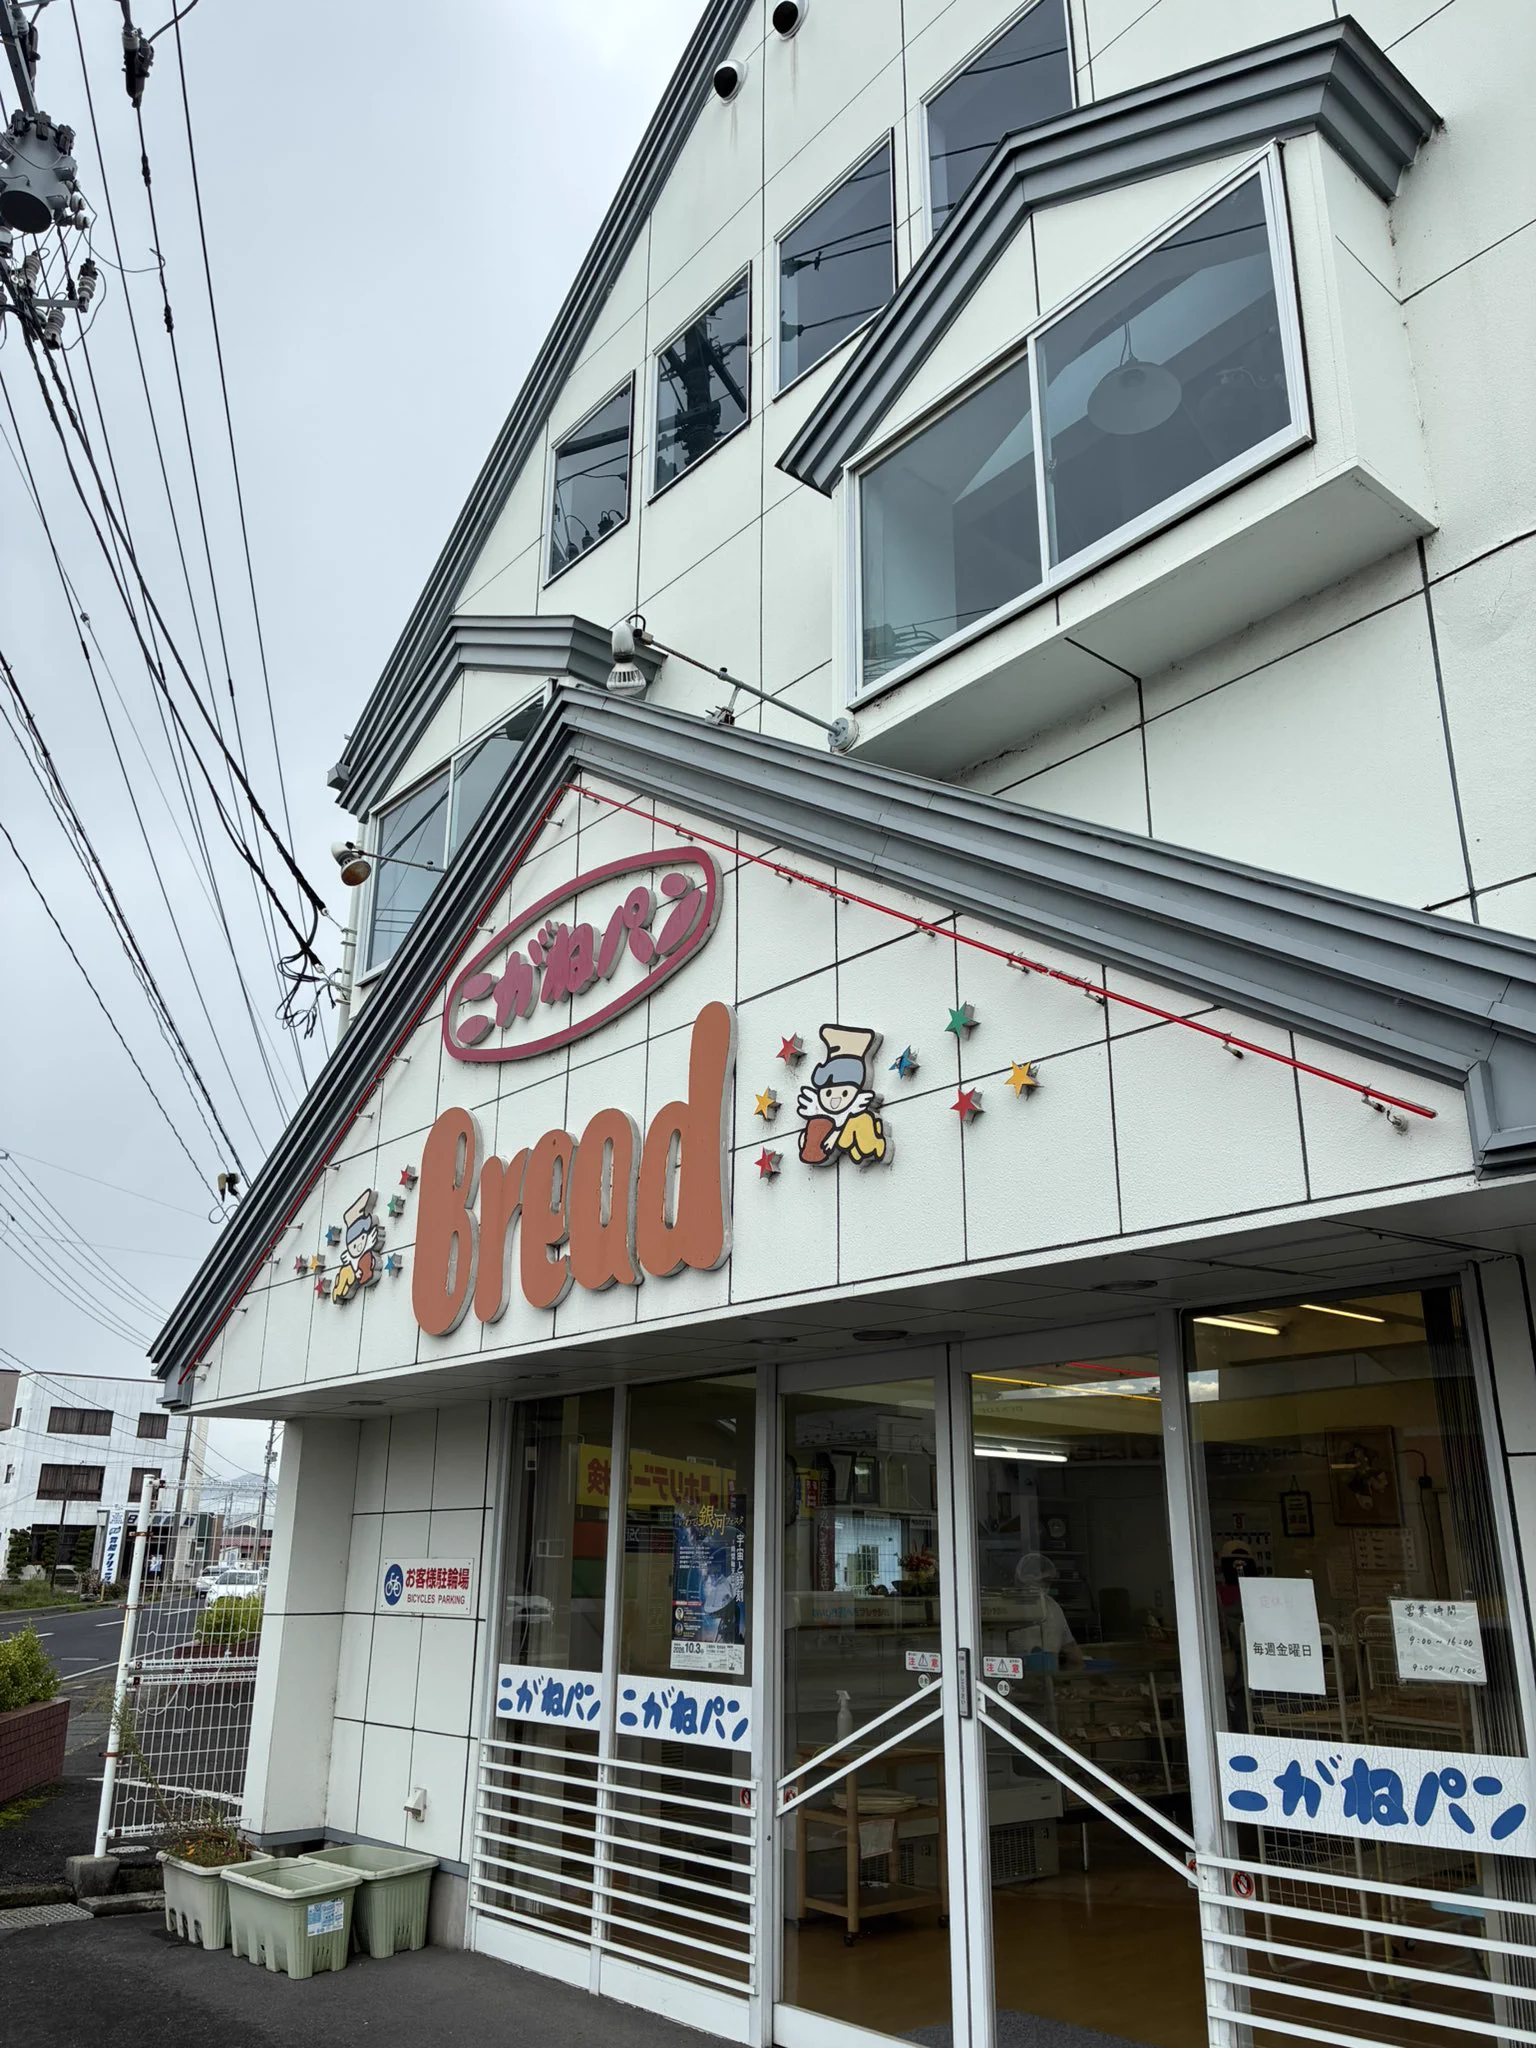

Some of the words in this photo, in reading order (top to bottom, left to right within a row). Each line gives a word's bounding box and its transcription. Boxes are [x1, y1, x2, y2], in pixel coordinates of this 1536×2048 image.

[456, 872, 706, 1045] こがねパン
[412, 1001, 737, 1337] Bread
[405, 1567, 470, 1590] お客様駐輪場
[407, 1594, 436, 1604] BICYCLES
[438, 1594, 466, 1605] PARKING
[1404, 1603, 1457, 1618] 営業時間
[1252, 1642, 1312, 1658] 毎週金曜日
[498, 1674, 601, 1722] こがねパン
[619, 1685, 749, 1742] こがねパン
[1228, 1754, 1527, 1840] こがねパン
